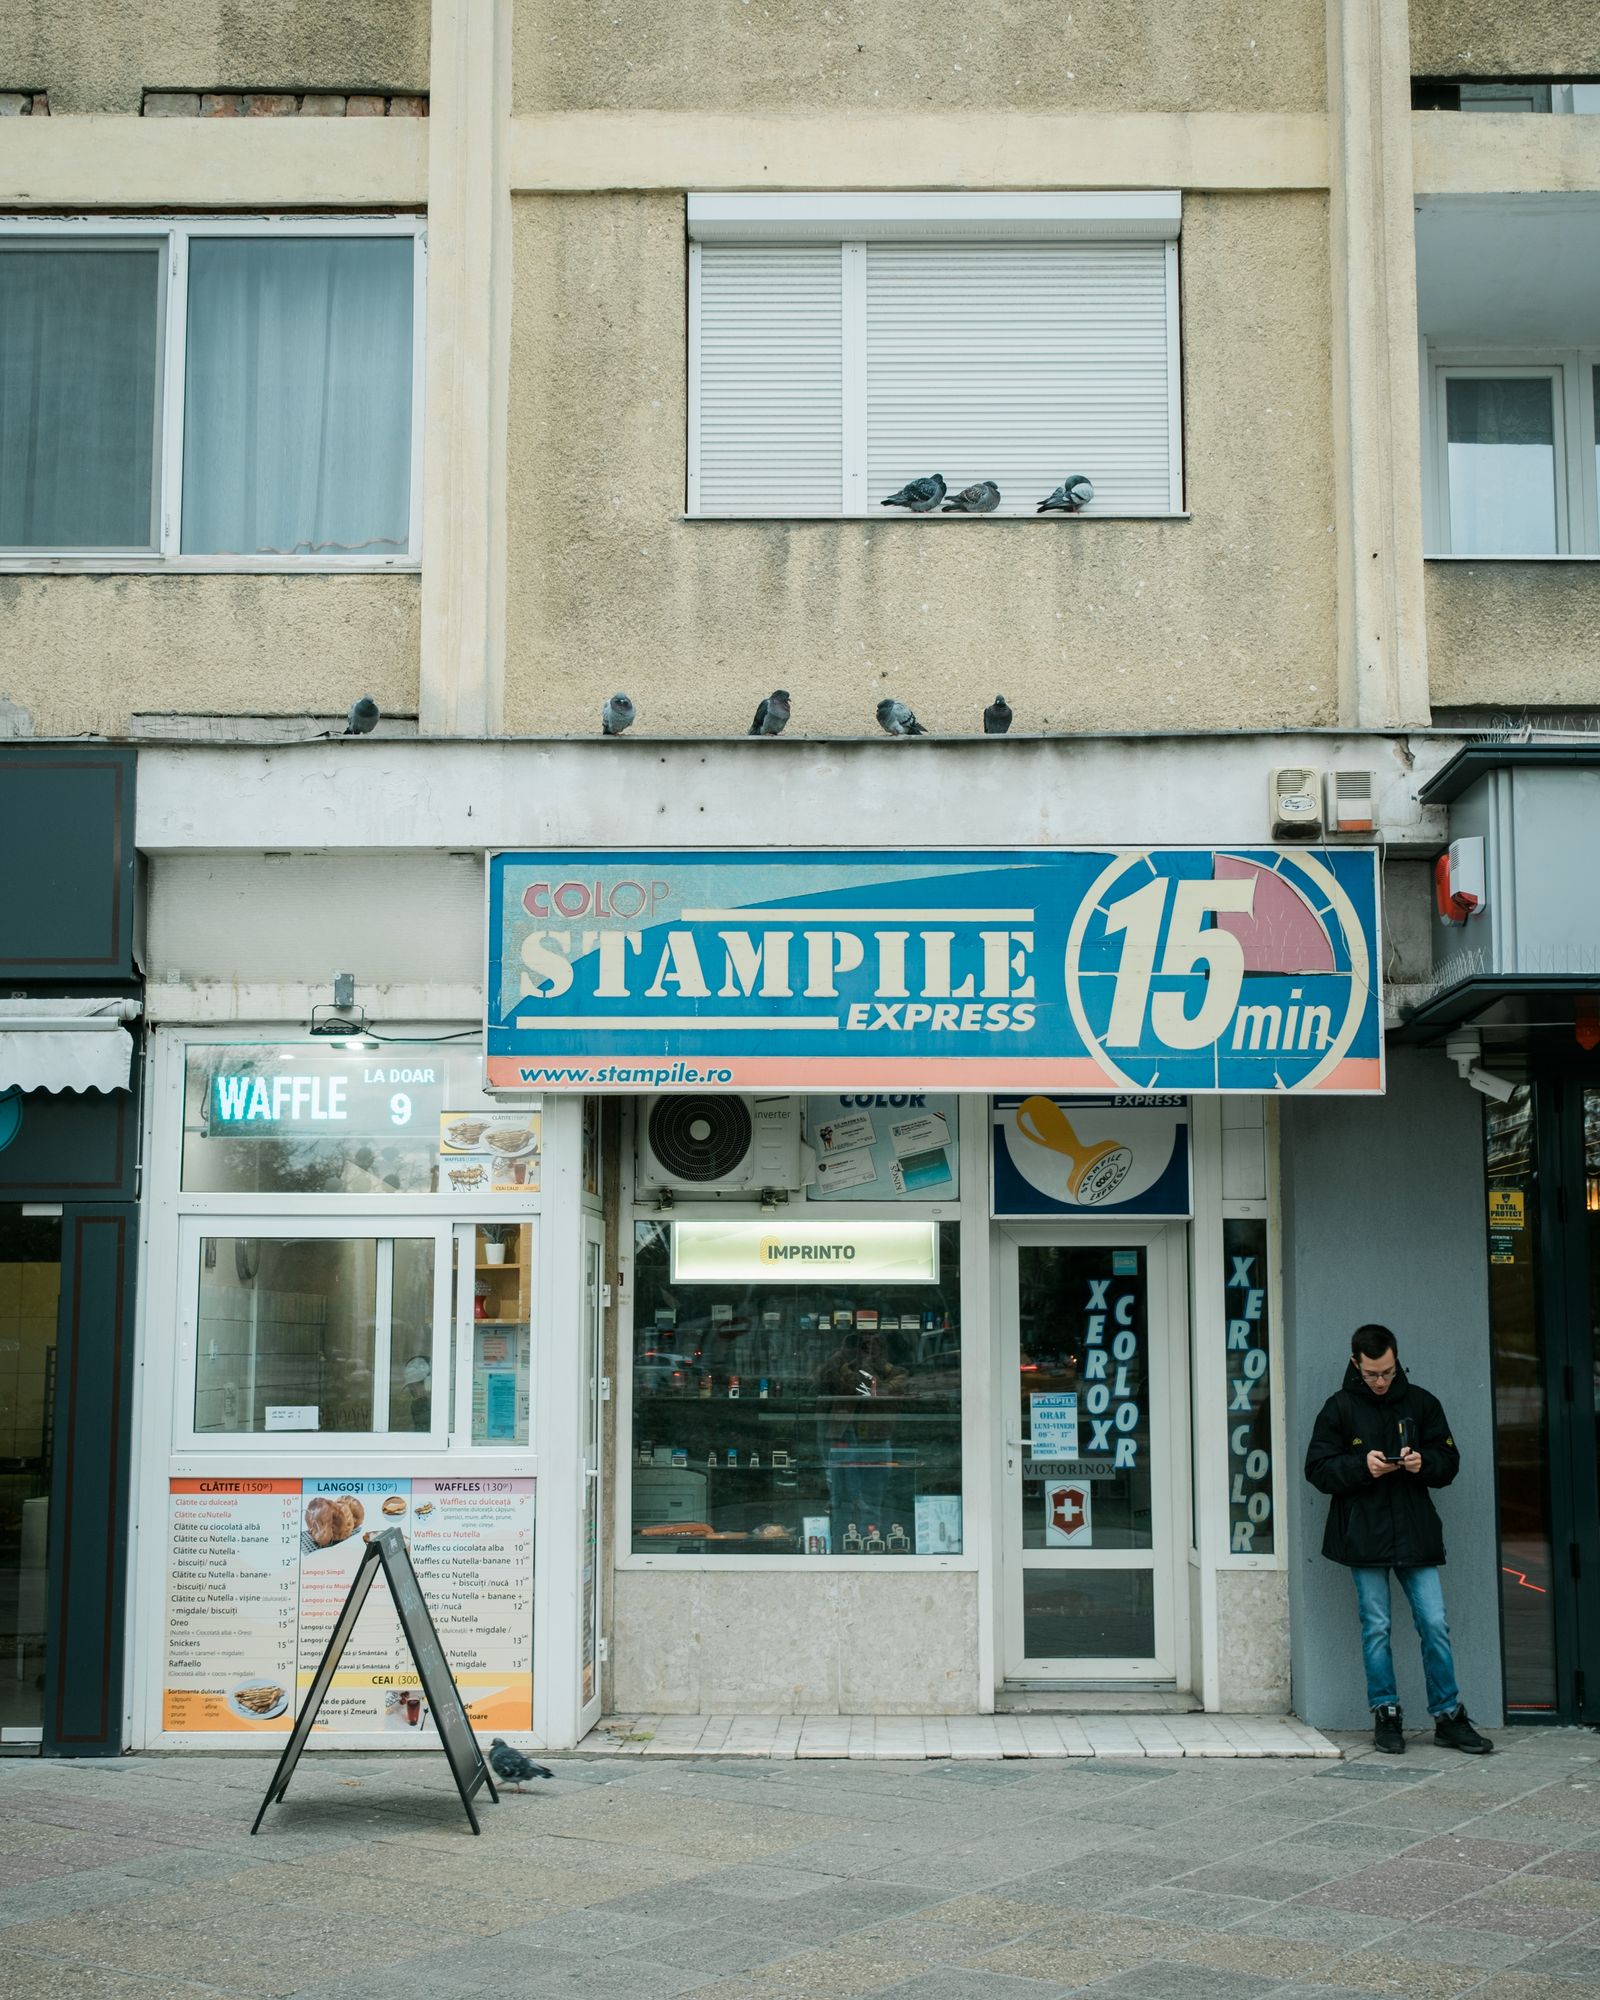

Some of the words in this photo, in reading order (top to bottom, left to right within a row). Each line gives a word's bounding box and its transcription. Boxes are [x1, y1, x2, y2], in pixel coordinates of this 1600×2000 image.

[521, 879, 671, 919] COLOP
[518, 929, 1036, 999] STAMPILE
[1104, 877, 1259, 1050] 15
[1232, 987, 1332, 1052] min
[846, 1002, 1037, 1032] EXPRESS
[364, 1069, 385, 1083] LA
[390, 1069, 435, 1083] DOAR
[518, 1063, 733, 1087] www.stampile.ro
[217, 1076, 348, 1120] WAFFLE
[839, 1094, 927, 1108] COLOR
[1114, 1095, 1182, 1106] EXPRESS
[390, 1093, 411, 1125] 9
[756, 1110, 791, 1119] inverter
[1090, 1166, 1126, 1200] EXPRESS
[768, 1245, 855, 1259] IMPRINTO
[1228, 1256, 1267, 1411] XEROX
[1085, 1280, 1114, 1450] XEROX
[1113, 1295, 1139, 1468] COLOR
[1024, 1464, 1115, 1475] VICTORINOX
[200, 1482, 240, 1492] CLĂTITE
[435, 1483, 480, 1491] WAFFLES
[1231, 1425, 1271, 1551] COLOR
[210, 1535, 236, 1543] Nutella
[476, 1627, 506, 1636] migdale
[170, 1639, 200, 1647] Snickers
[456, 1661, 486, 1669] migdale
